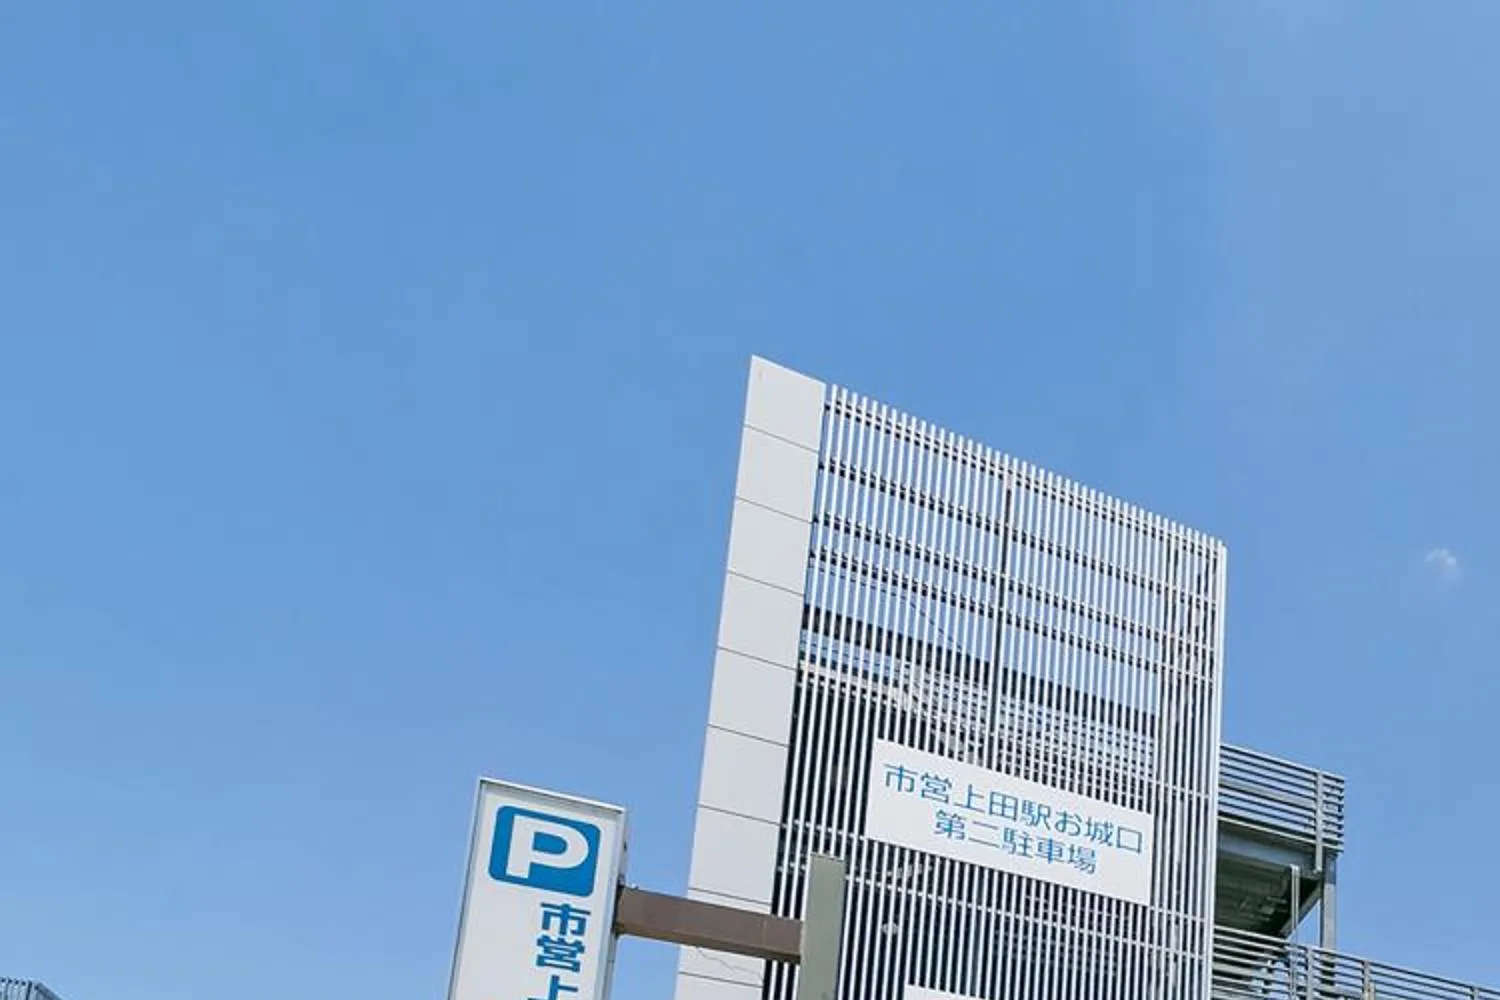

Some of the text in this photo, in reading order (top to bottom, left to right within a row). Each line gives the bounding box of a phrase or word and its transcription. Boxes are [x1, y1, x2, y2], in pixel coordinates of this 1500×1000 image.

[883, 762, 1143, 855] 市営上田駅お城口
[505, 814, 590, 879] P
[934, 809, 1097, 876] 第二駐車場
